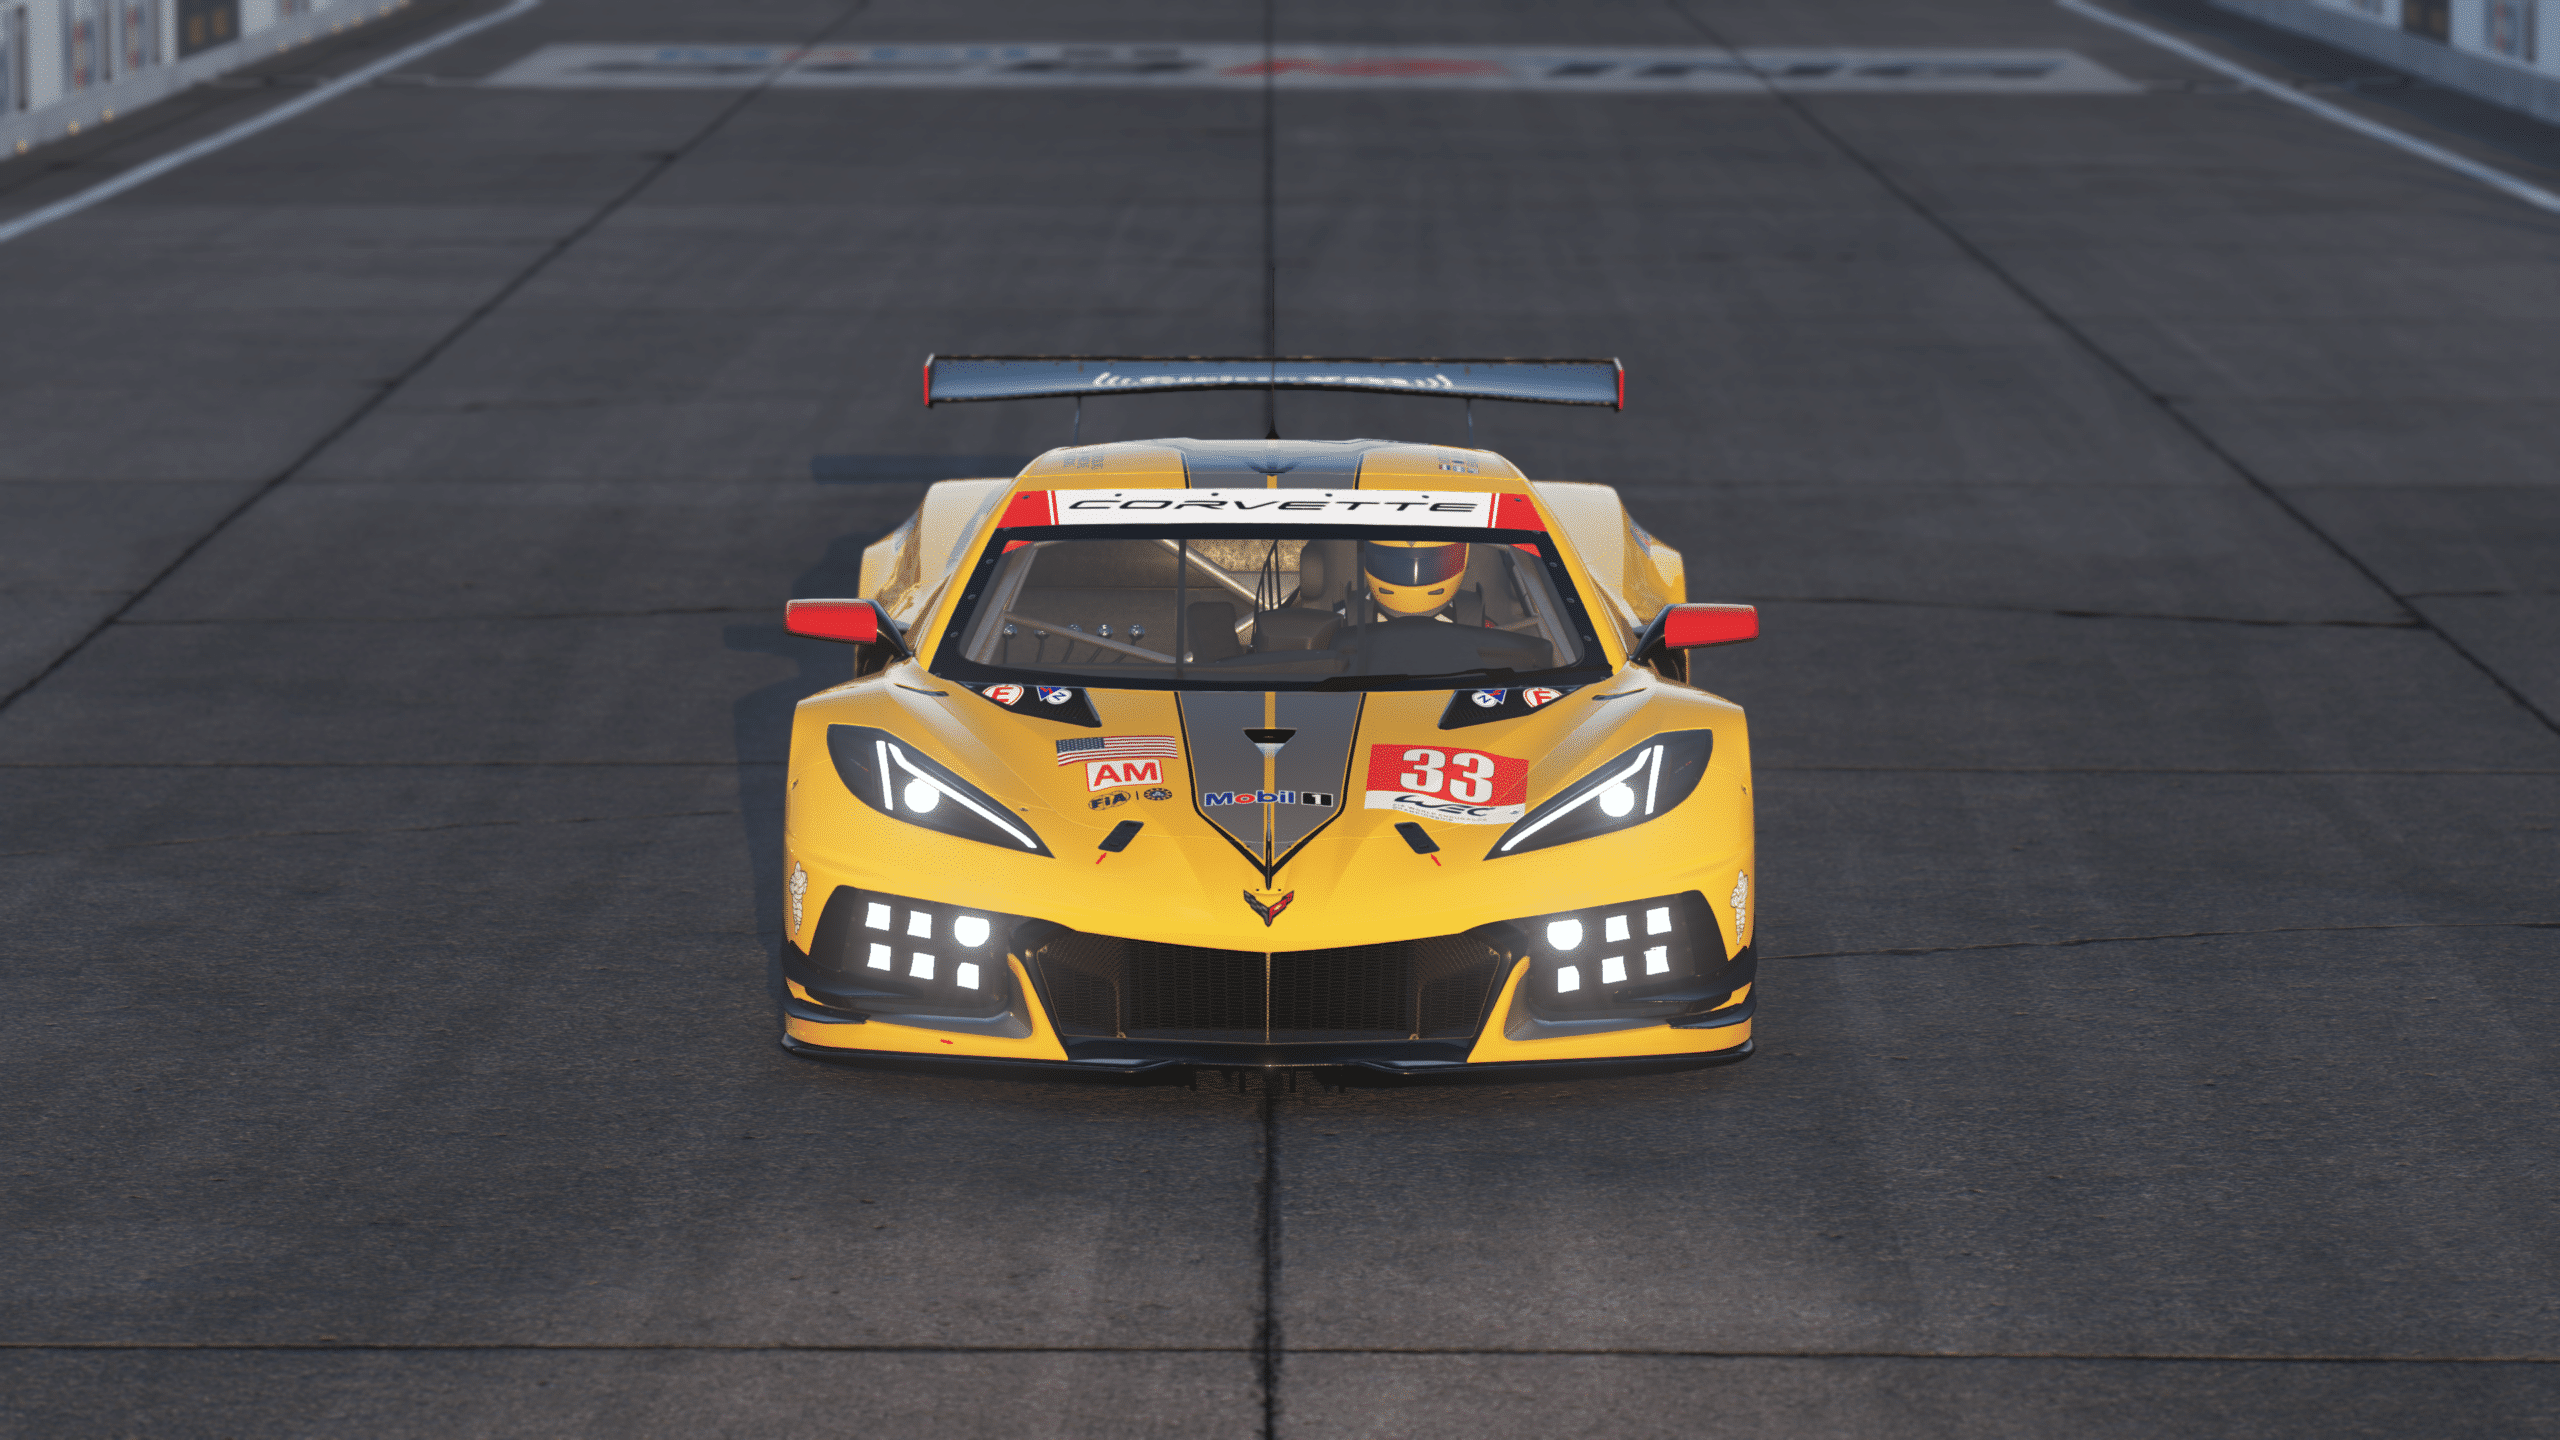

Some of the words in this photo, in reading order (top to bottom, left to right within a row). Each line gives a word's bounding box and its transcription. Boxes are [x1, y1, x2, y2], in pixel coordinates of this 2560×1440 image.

[1068, 499, 1479, 513] CORVETTE
[1093, 762, 1158, 787] AM
[1400, 748, 1496, 804] 33
[1090, 792, 1128, 810] FIA
[1203, 789, 1297, 807] Mobil
[1394, 794, 1498, 817] WEC
